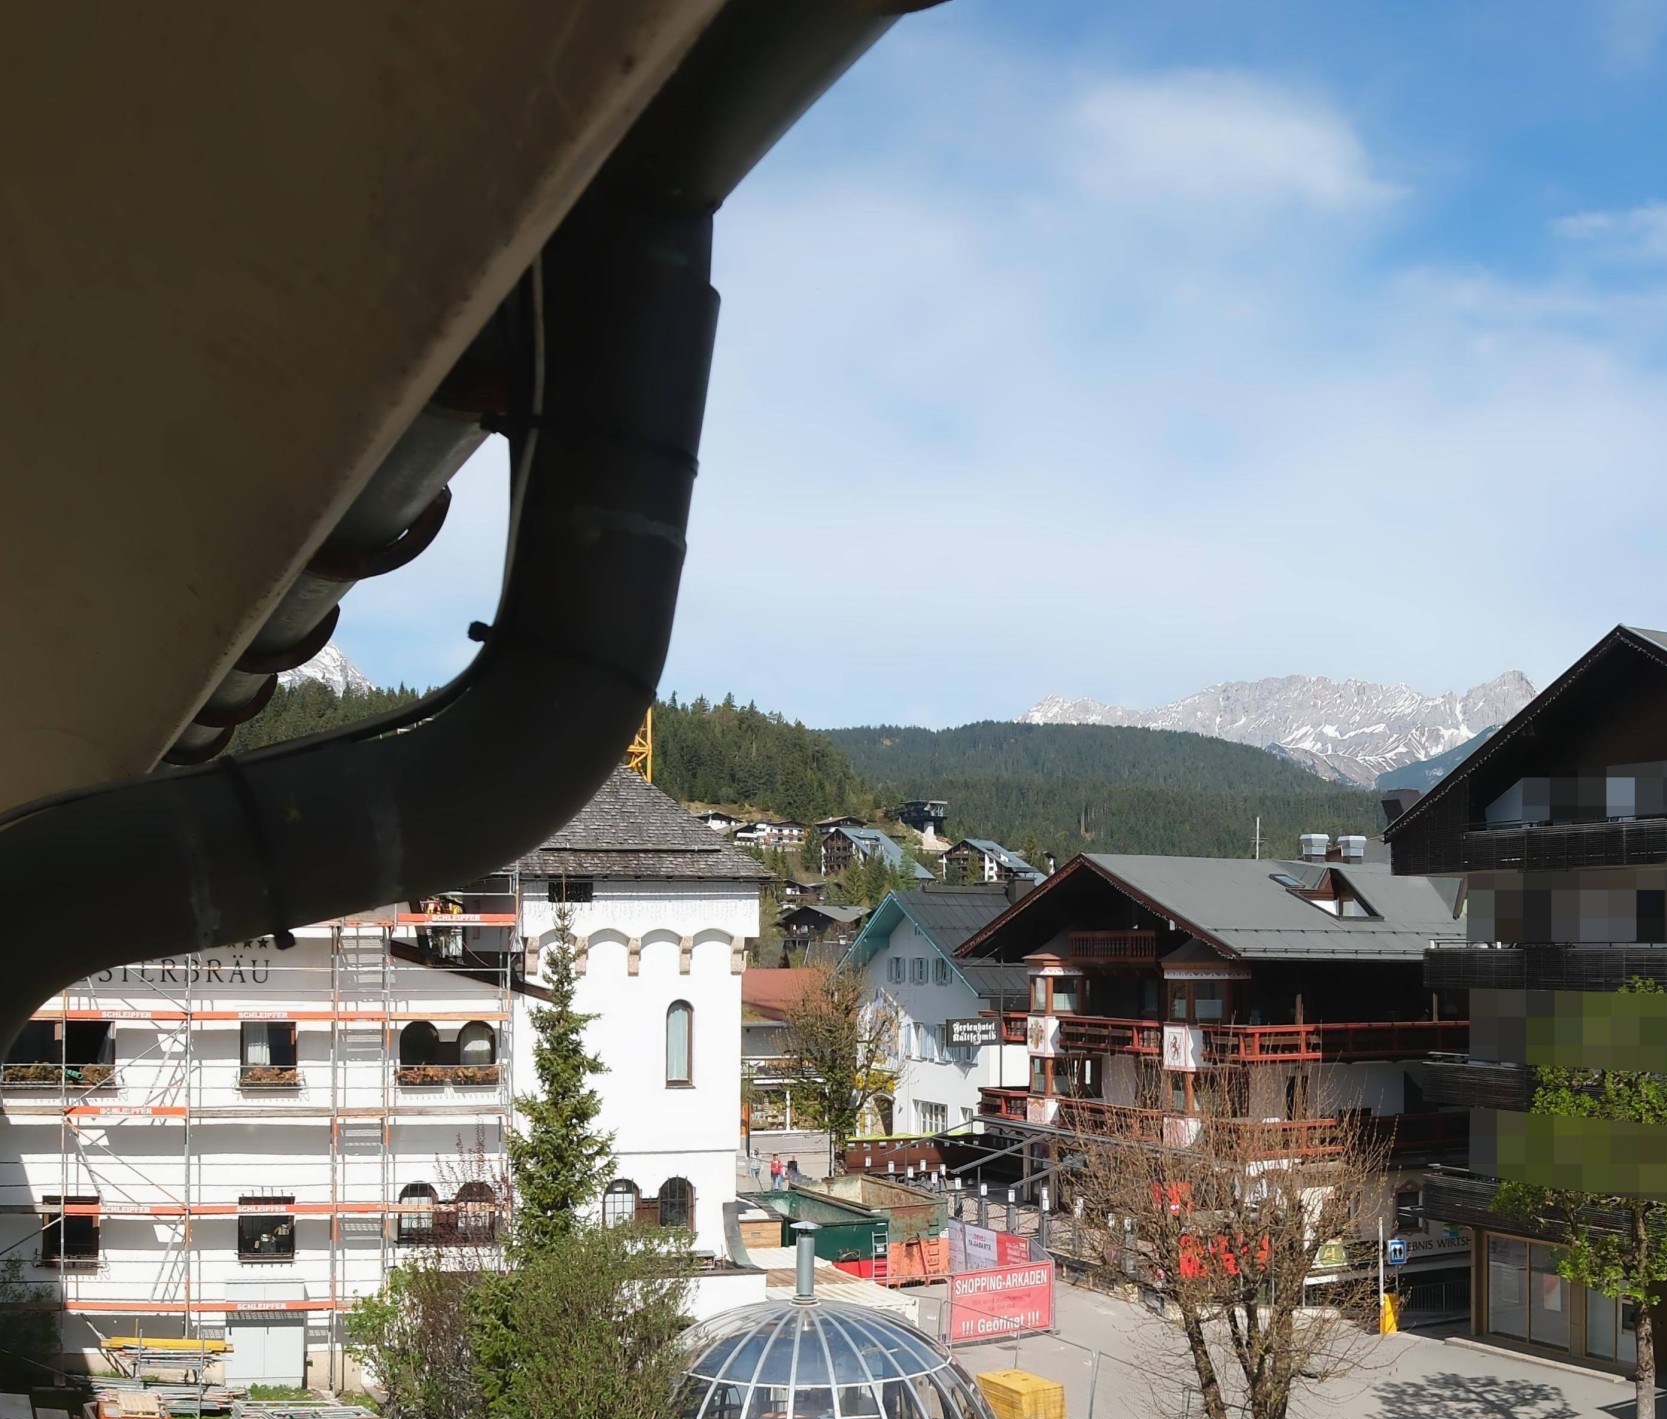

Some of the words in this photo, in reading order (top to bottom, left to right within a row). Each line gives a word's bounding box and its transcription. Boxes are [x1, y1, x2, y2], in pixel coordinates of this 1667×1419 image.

[431, 914, 482, 922] SCHLEIPFER
[101, 1011, 152, 1019] SCHLEIPFER
[238, 1011, 288, 1019] SCHLEIPFER
[100, 1205, 150, 1213] SCHLEIPFER
[236, 1205, 286, 1213] SCHLEIPFER
[955, 1269, 1048, 1295] SHOPPING-ARKADEN
[236, 1302, 287, 1310] SCHLEIPFER
